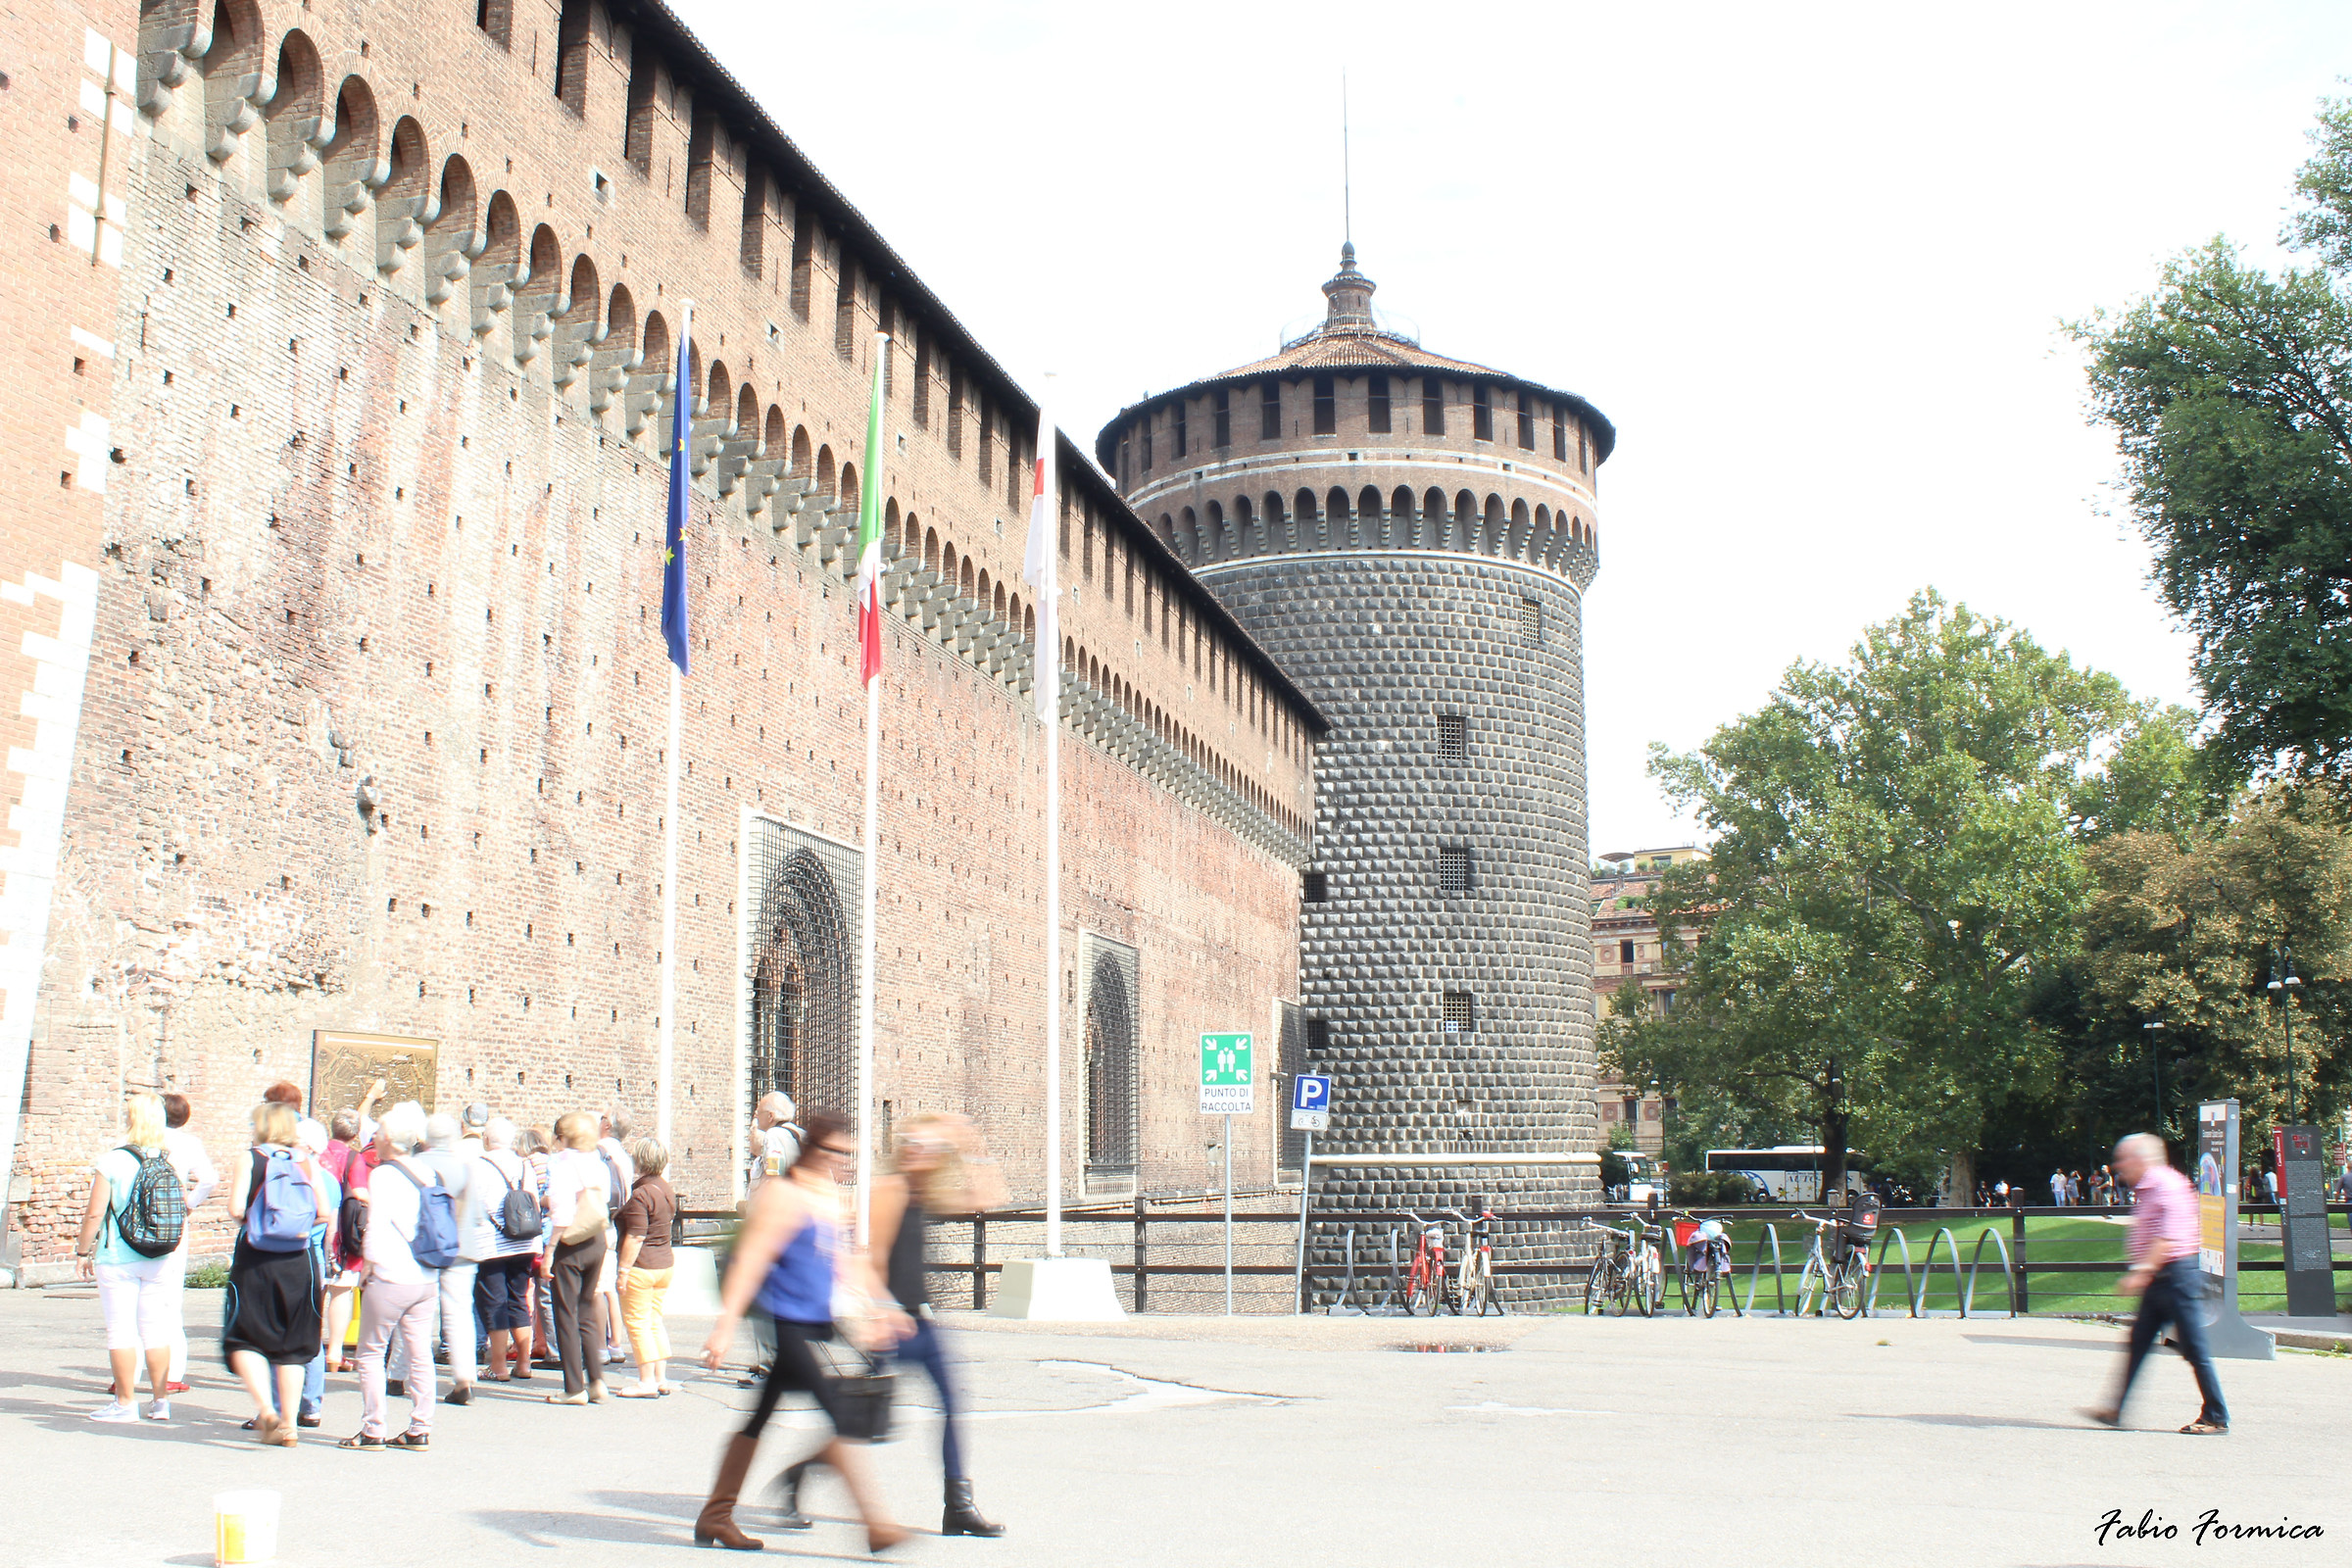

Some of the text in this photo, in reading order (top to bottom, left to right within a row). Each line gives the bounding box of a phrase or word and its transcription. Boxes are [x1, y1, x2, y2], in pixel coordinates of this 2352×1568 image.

[1204, 1088, 1249, 1098] PUNTO DI
[1300, 1079, 1323, 1107] P
[1201, 1102, 1251, 1112] RACCOLTA
